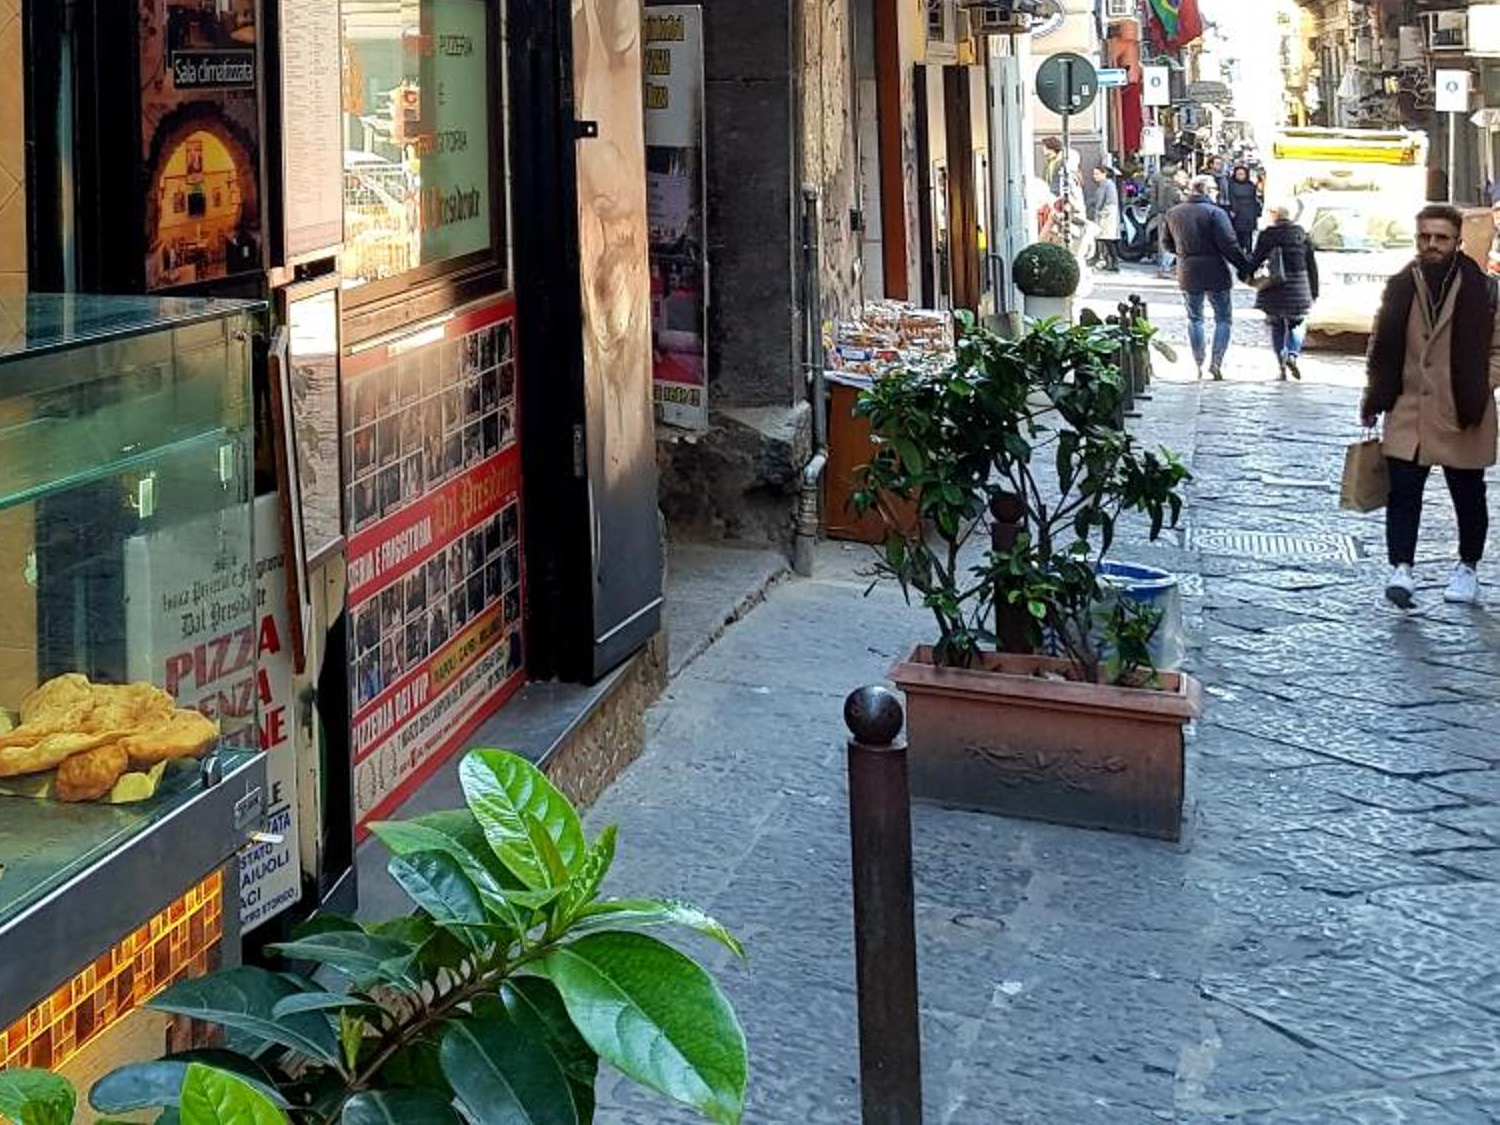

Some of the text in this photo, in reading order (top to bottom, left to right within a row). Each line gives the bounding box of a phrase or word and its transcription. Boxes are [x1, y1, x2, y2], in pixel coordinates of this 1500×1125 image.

[176, 59, 197, 84] Sala
[164, 613, 281, 699] PIZZA
[184, 668, 272, 717] ENZA
